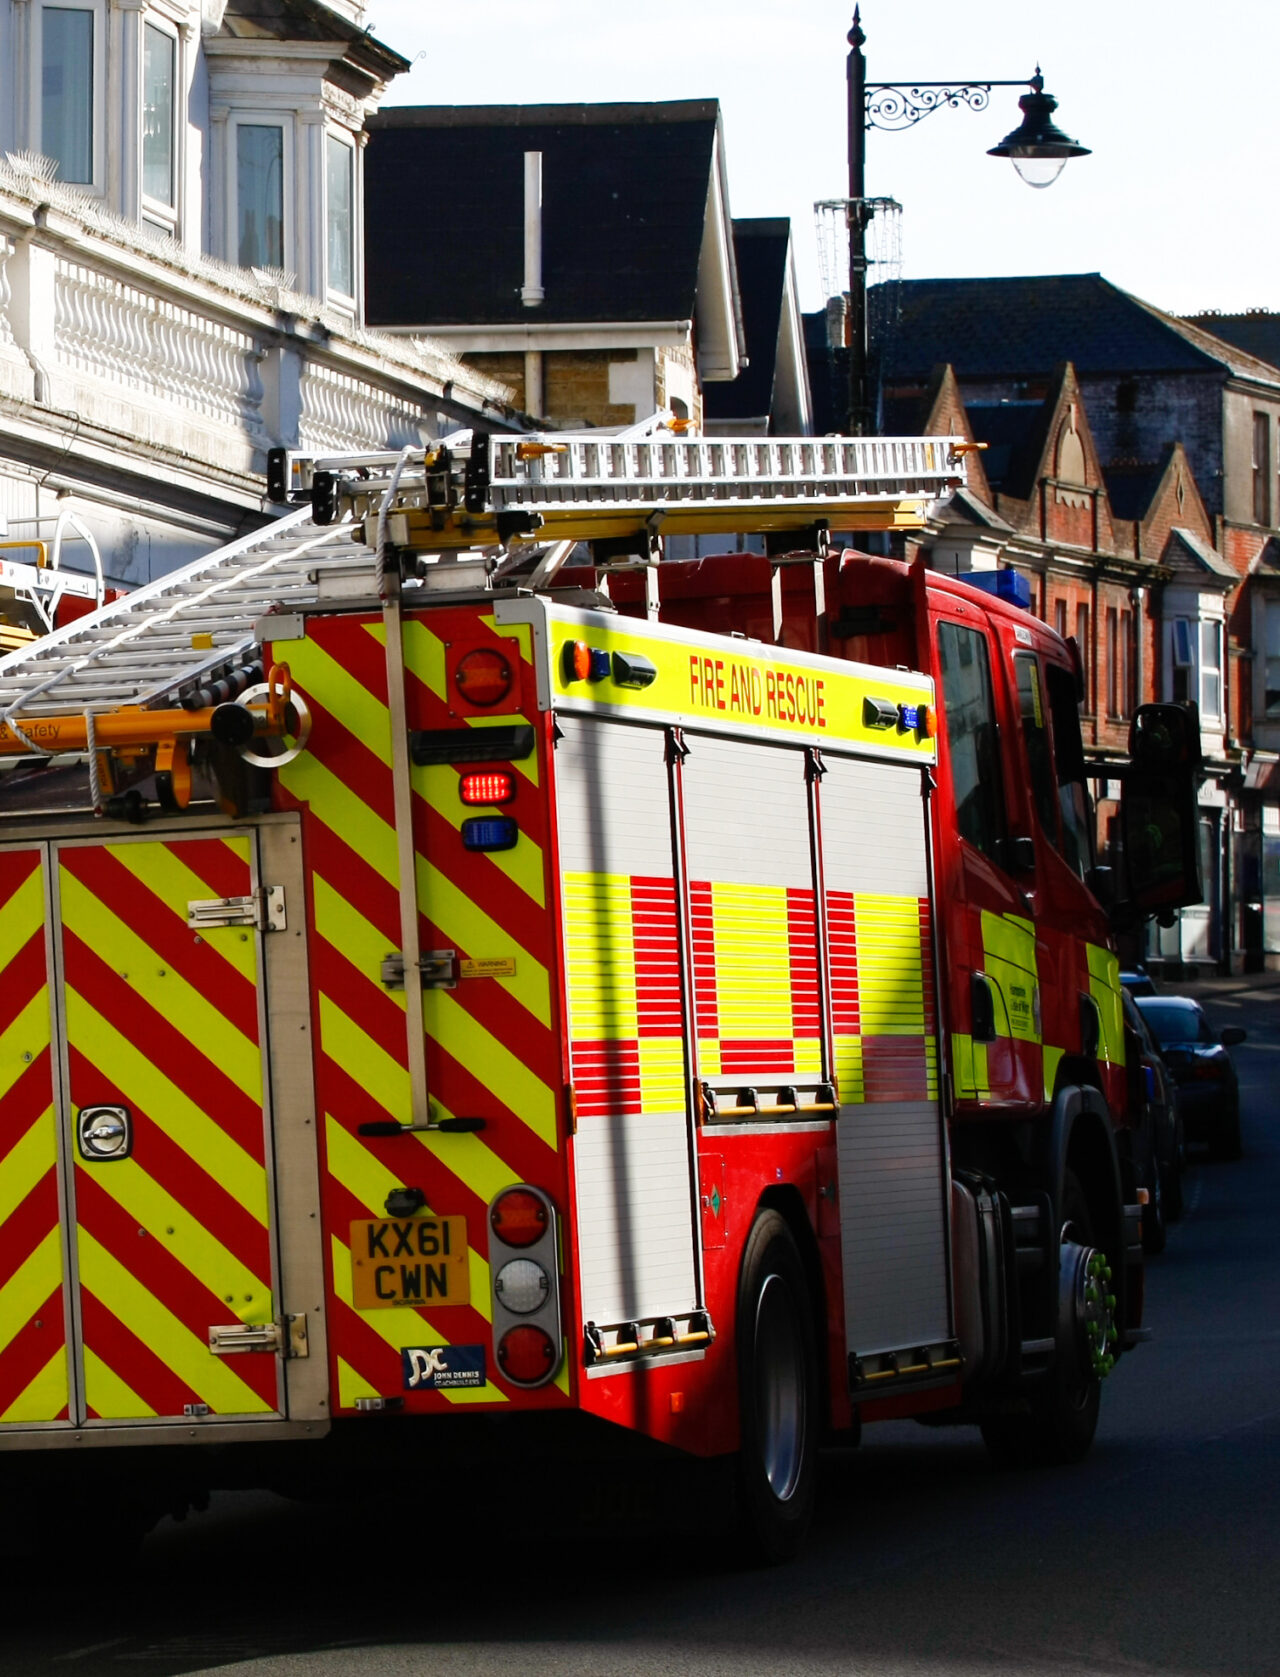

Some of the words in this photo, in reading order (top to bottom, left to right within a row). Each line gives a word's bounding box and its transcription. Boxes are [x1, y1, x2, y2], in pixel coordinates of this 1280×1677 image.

[690, 655, 726, 710] FIRE
[730, 664, 762, 716] AND
[765, 670, 826, 727] RESCUE
[367, 1221, 450, 1258] KX61
[374, 1263, 448, 1299] CWN
[434, 1371, 452, 1380] JOHN
[453, 1370, 479, 1379] DENNIS
